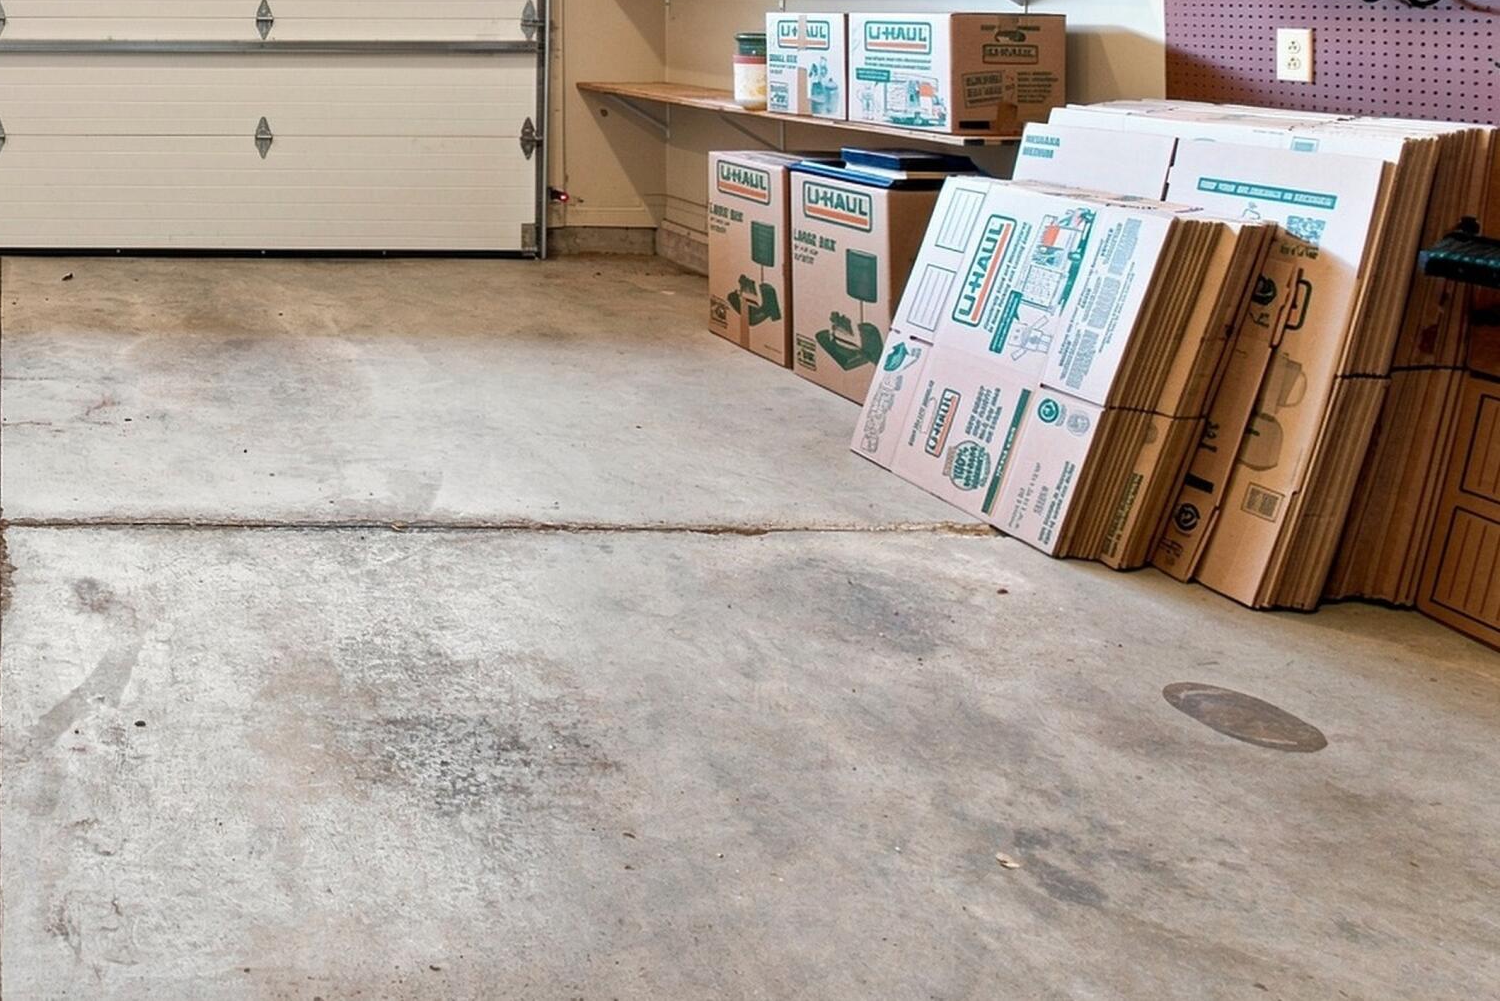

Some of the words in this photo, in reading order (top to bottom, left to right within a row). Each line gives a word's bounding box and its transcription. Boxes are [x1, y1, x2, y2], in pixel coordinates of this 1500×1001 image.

[868, 25, 927, 42] U-HAUL
[720, 164, 767, 191] U-HAUL
[807, 184, 868, 217] U-HAUL
[958, 224, 1004, 316] U-HAUL
